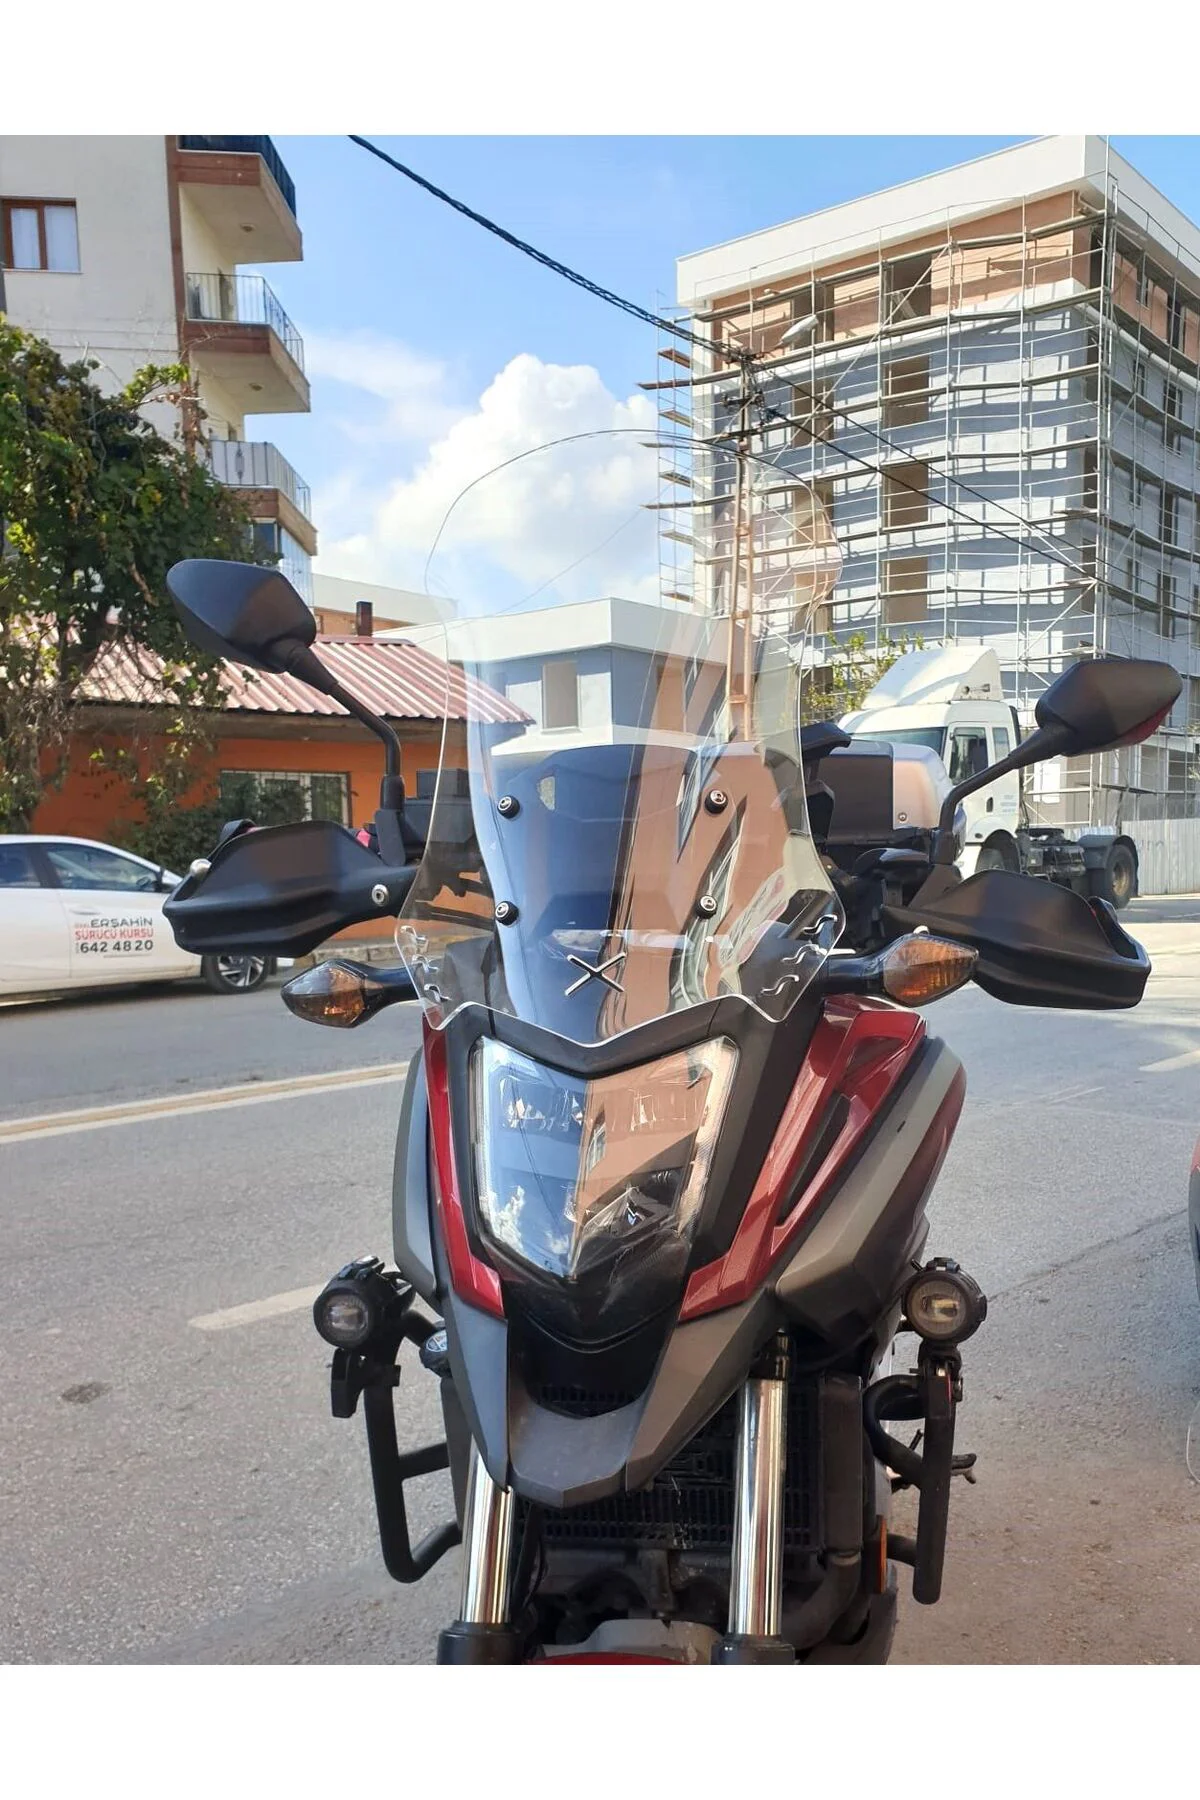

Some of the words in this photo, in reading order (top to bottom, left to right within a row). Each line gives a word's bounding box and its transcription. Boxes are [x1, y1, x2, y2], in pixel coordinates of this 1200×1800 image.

[119, 928, 154, 939] KURSU
[80, 941, 108, 953] 642
[112, 940, 132, 951] 48
[135, 939, 154, 951] 20
